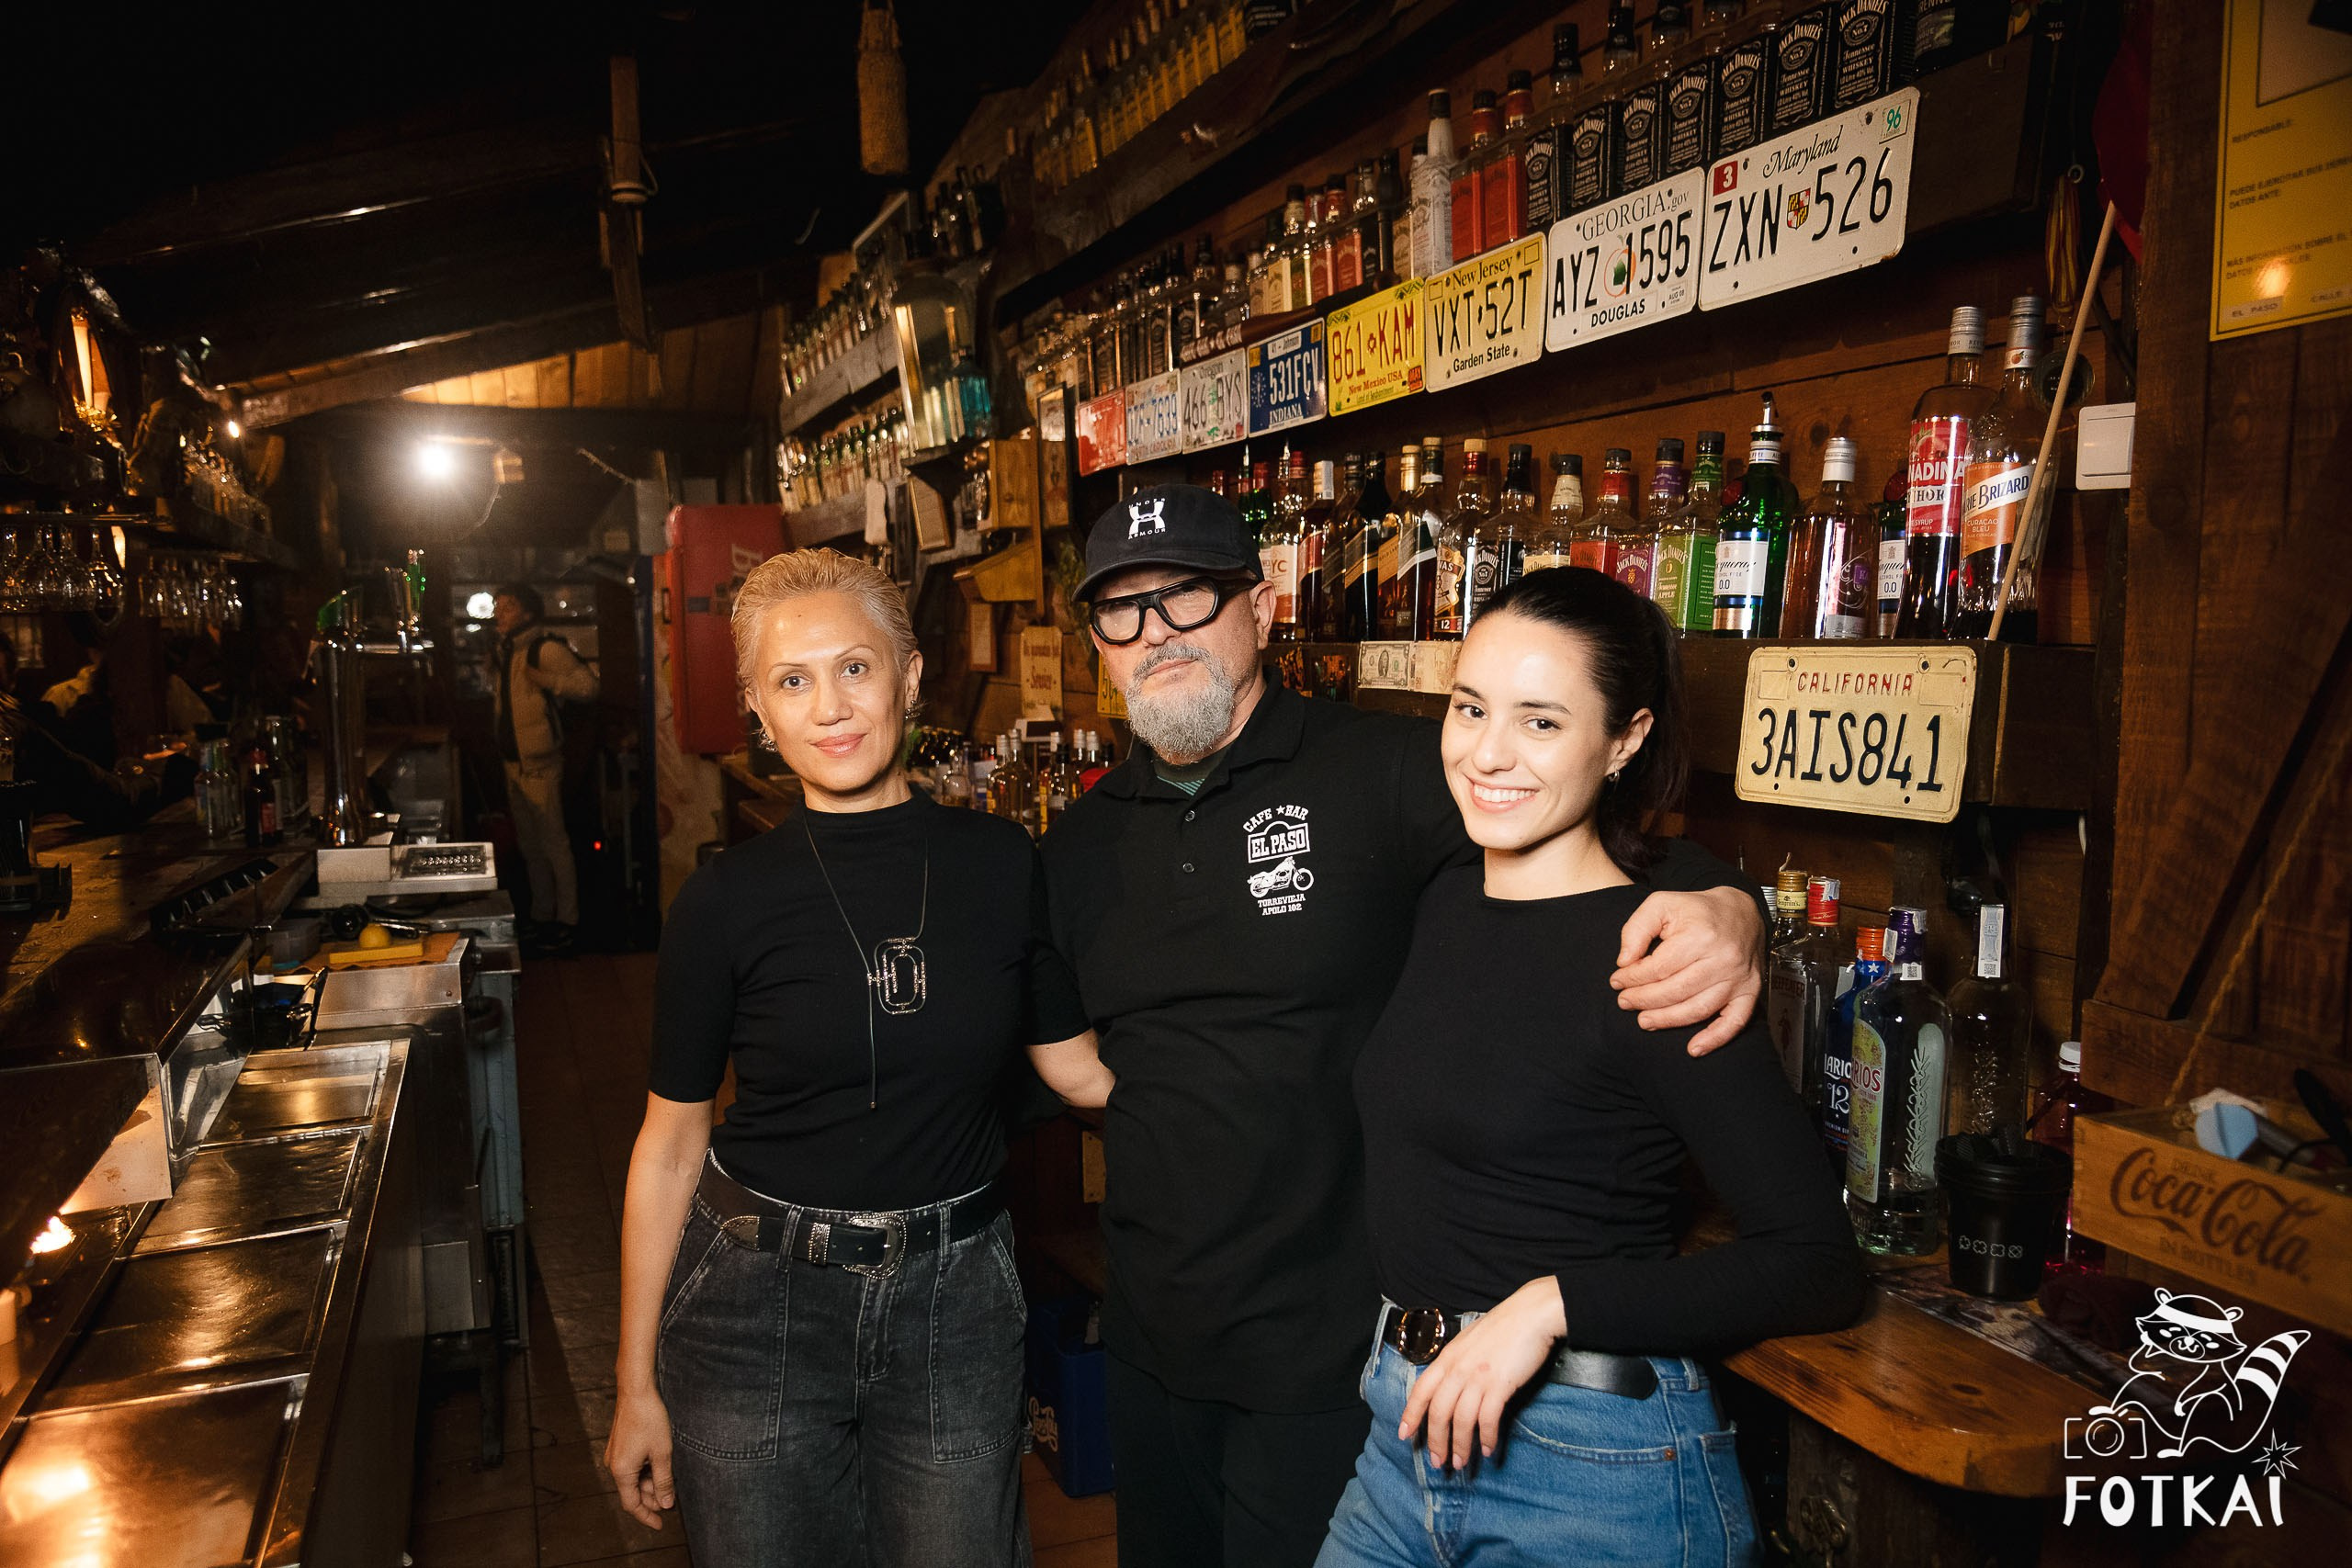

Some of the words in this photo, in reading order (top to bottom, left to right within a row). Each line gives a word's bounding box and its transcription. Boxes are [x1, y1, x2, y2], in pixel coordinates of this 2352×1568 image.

[1840, 7, 1857, 31] JACK
[1857, 0, 1889, 15] DANIEL'S
[1779, 30, 1793, 53] JACK
[1794, 23, 1823, 39] DANIEL'S
[1844, 44, 1875, 60] Tennessee
[1722, 61, 1735, 81] JACK
[1735, 52, 1761, 69] DANIEL'S
[1781, 67, 1810, 84] Tennessee
[1842, 57, 1873, 73] WHISKEY
[1668, 86, 1682, 105] JACK
[1682, 75, 1708, 91] DANIEL'S
[1780, 80, 1808, 96] WHISKEY
[1634, 98, 1657, 113] DANIEL'S
[1724, 108, 1748, 123] WHISKEY
[1584, 118, 1606, 133] DANIEL'S
[1886, 105, 1901, 131] 96
[1762, 124, 1844, 178] Maryland
[1723, 166, 1734, 188] 3
[1709, 184, 1782, 273] ZXN
[1812, 147, 1893, 242] 526
[1453, 271, 1476, 290] New
[1477, 256, 1513, 285] Jersey
[1553, 245, 1600, 319] AYZ
[1625, 209, 1693, 295] 1595
[1434, 289, 1475, 356] VXT
[1485, 269, 1532, 339] 52T
[1591, 299, 1645, 328] DOUGLAS
[1332, 321, 1366, 383] 861
[1378, 299, 1415, 369] KAM
[1453, 352, 1484, 373] Garden
[1487, 344, 1510, 364] State
[1270, 347, 1318, 405] 531FCV
[1349, 382, 1362, 396] New
[1363, 374, 1386, 391] Mexico
[1387, 369, 1403, 383] USA
[1184, 383, 1207, 432] 466
[1270, 403, 1302, 423] INDIANA
[1907, 461, 1964, 483] NADINA
[1129, 497, 1166, 508] UNDER
[1965, 492, 1977, 512] RIE
[1977, 475, 2030, 509] BRIZARD
[1915, 518, 1934, 526] SYRUP
[1128, 528, 1166, 539] ARMOUR
[1482, 549, 1499, 568] DANIEL'S
[1617, 560, 1629, 574] JACK
[1629, 554, 1648, 572] DANIEL'S
[1668, 544, 1689, 564] DANIEL'S
[1272, 559, 1287, 574] YC
[1439, 560, 1454, 572] VAS
[1716, 559, 1757, 572] queray
[1657, 591, 1675, 599] APPLE
[1719, 579, 1731, 590] 0.0
[1883, 581, 1897, 593] 0.0
[1441, 619, 1451, 630] 12
[1797, 671, 1915, 696] CALIFORNIA
[1750, 706, 1943, 793] 3AIS841
[1243, 808, 1272, 832] CAFE
[1284, 805, 1309, 821] BAR
[1251, 838, 1270, 858] EL
[1271, 829, 1306, 854] PASO
[1258, 893, 1306, 908] TORREVIEJA
[1261, 905, 1286, 916] APOLO
[1287, 903, 1303, 912] 102
[1824, 1054, 1852, 1080] LARIO
[1851, 1058, 1881, 1092] RIOS
[1827, 1082, 1849, 1114] 12
